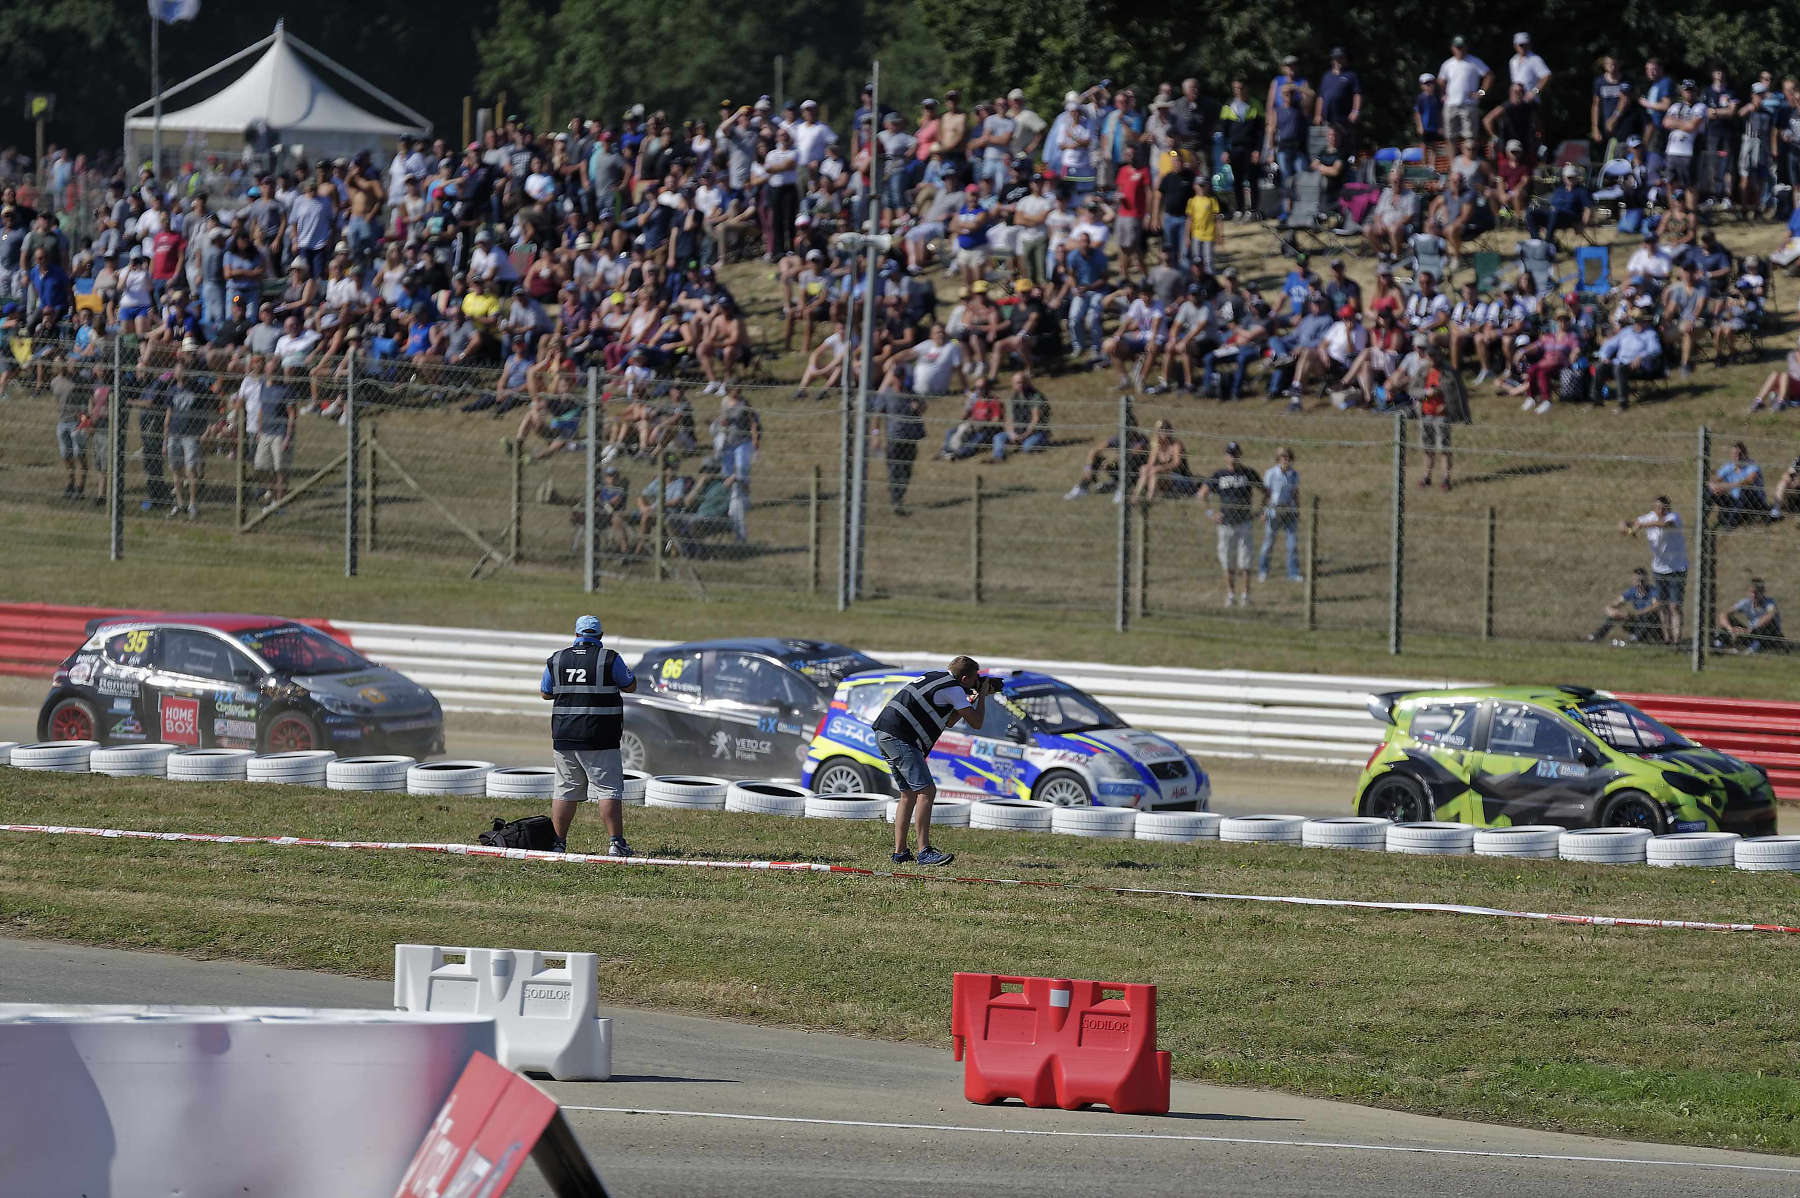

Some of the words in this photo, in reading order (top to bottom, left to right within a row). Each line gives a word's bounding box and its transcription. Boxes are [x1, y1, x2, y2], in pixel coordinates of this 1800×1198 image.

[124, 631, 149, 653] 35
[566, 669, 586, 682] 72
[662, 658, 683, 679] 66
[166, 707, 194, 721] HOME
[166, 720, 194, 734] BOX
[1449, 709, 1466, 735] 7
[525, 988, 569, 1000] SODILOR
[1083, 1019, 1129, 1031] SODILOR
